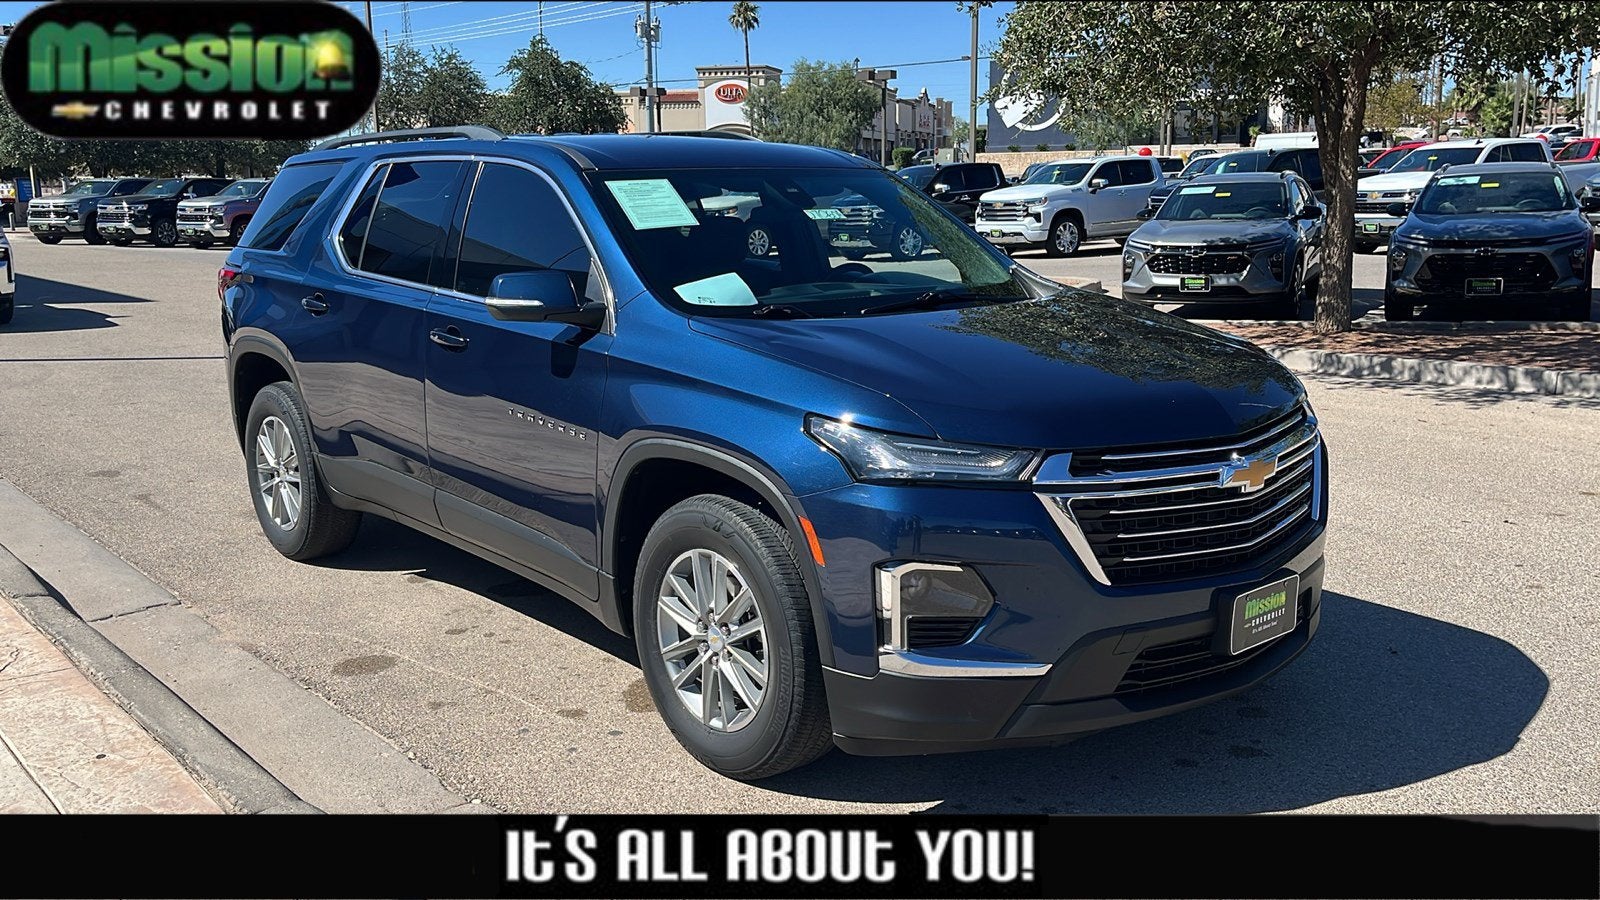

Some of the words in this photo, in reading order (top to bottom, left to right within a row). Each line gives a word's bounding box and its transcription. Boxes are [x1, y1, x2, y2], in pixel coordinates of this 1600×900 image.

[720, 87, 744, 96] ULTA
[508, 408, 587, 440] TRAVERSE
[1244, 591, 1287, 619] Mission
[1251, 608, 1286, 626] CHEVROLET
[769, 645, 791, 736] BRIDGESTONE
